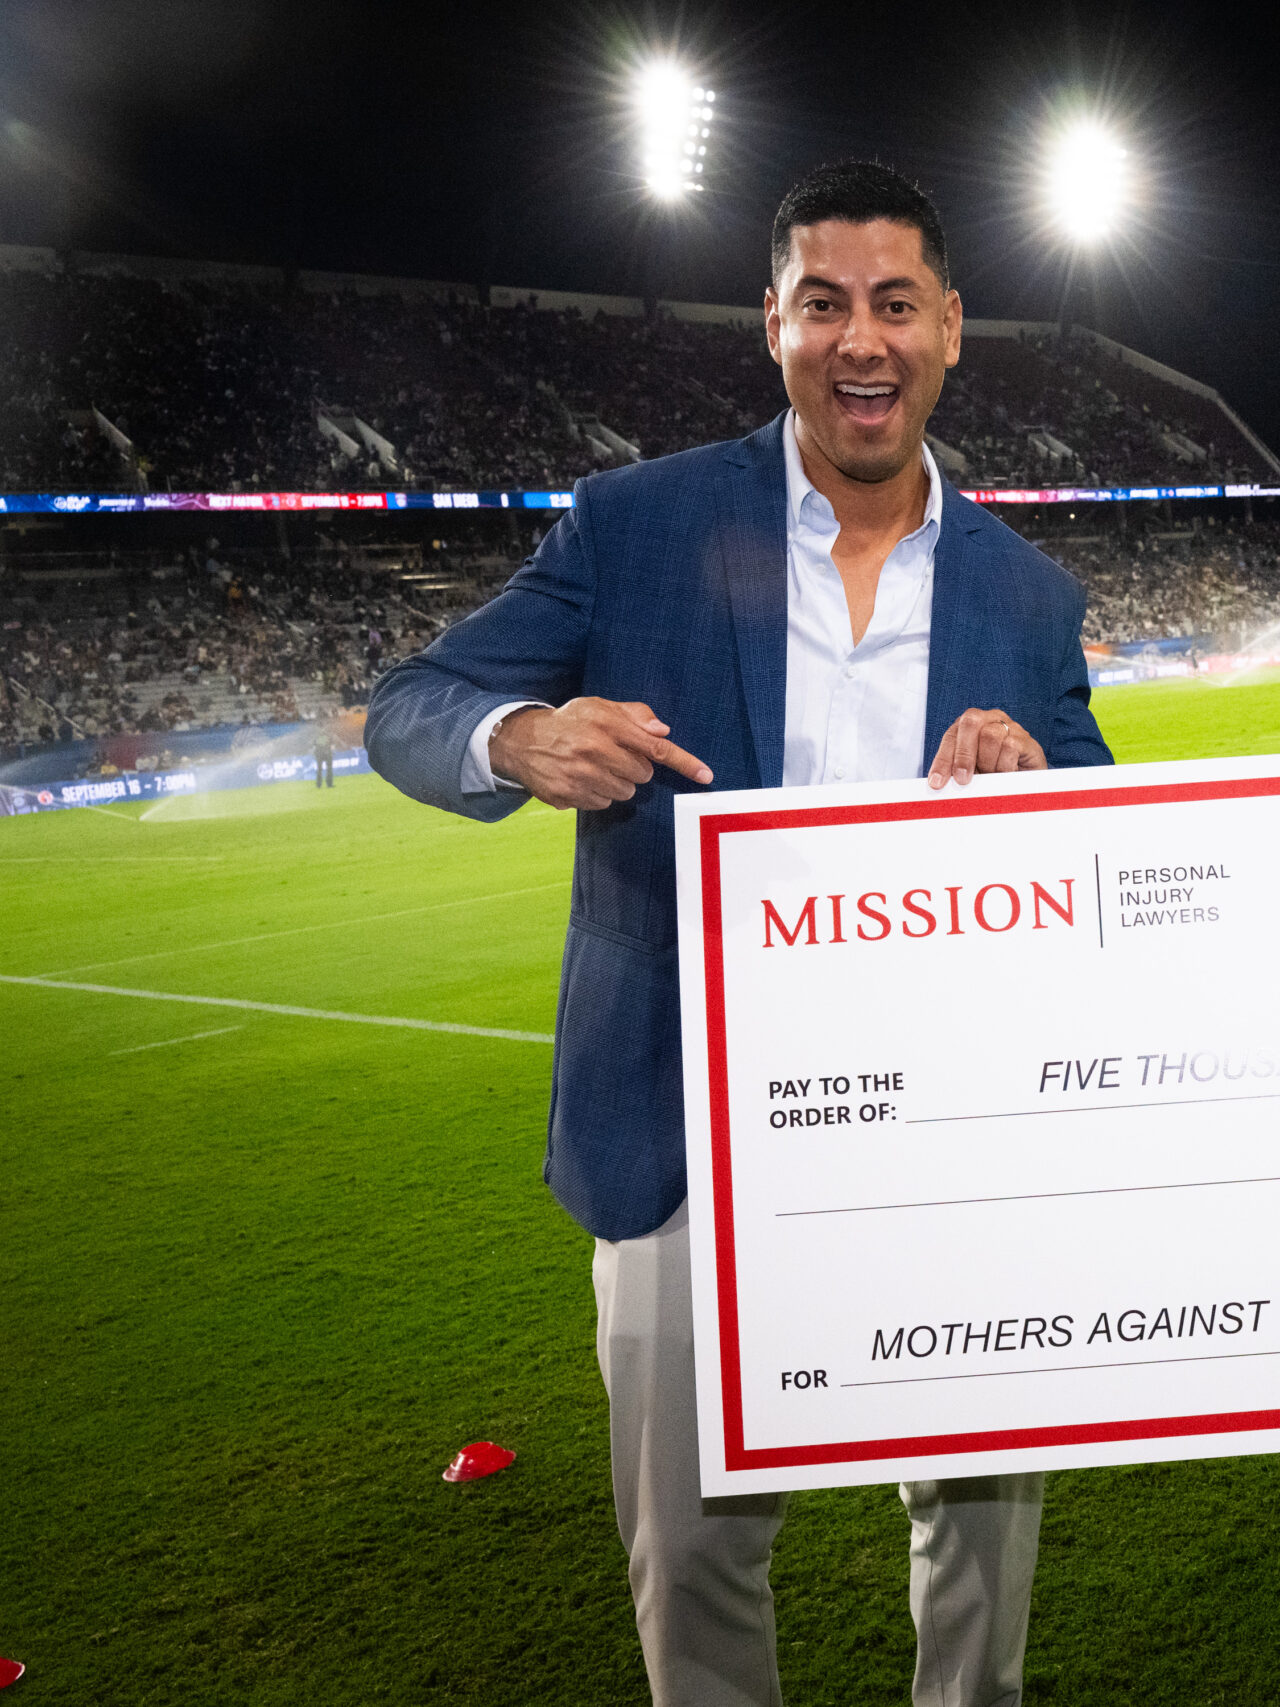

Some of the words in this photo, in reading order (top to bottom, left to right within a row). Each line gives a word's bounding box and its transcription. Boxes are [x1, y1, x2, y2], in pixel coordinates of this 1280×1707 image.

[61, 780, 127, 803] SEPTEMBER
[127, 779, 141, 796] 16
[1119, 864, 1231, 886] PERSONAL
[1120, 887, 1194, 906] INJURY
[761, 879, 1075, 948] MISSION
[1121, 906, 1220, 927] LAWYERS
[769, 1078, 810, 1099] PAY
[818, 1076, 851, 1096] TO
[857, 1072, 905, 1094] THE
[1039, 1056, 1123, 1093] FIVE
[769, 1105, 852, 1129] ORDER
[858, 1103, 897, 1123] OF:
[871, 1315, 1075, 1361] MOTHERS
[1086, 1300, 1271, 1345] AGAINST
[781, 1368, 829, 1391] FOR
